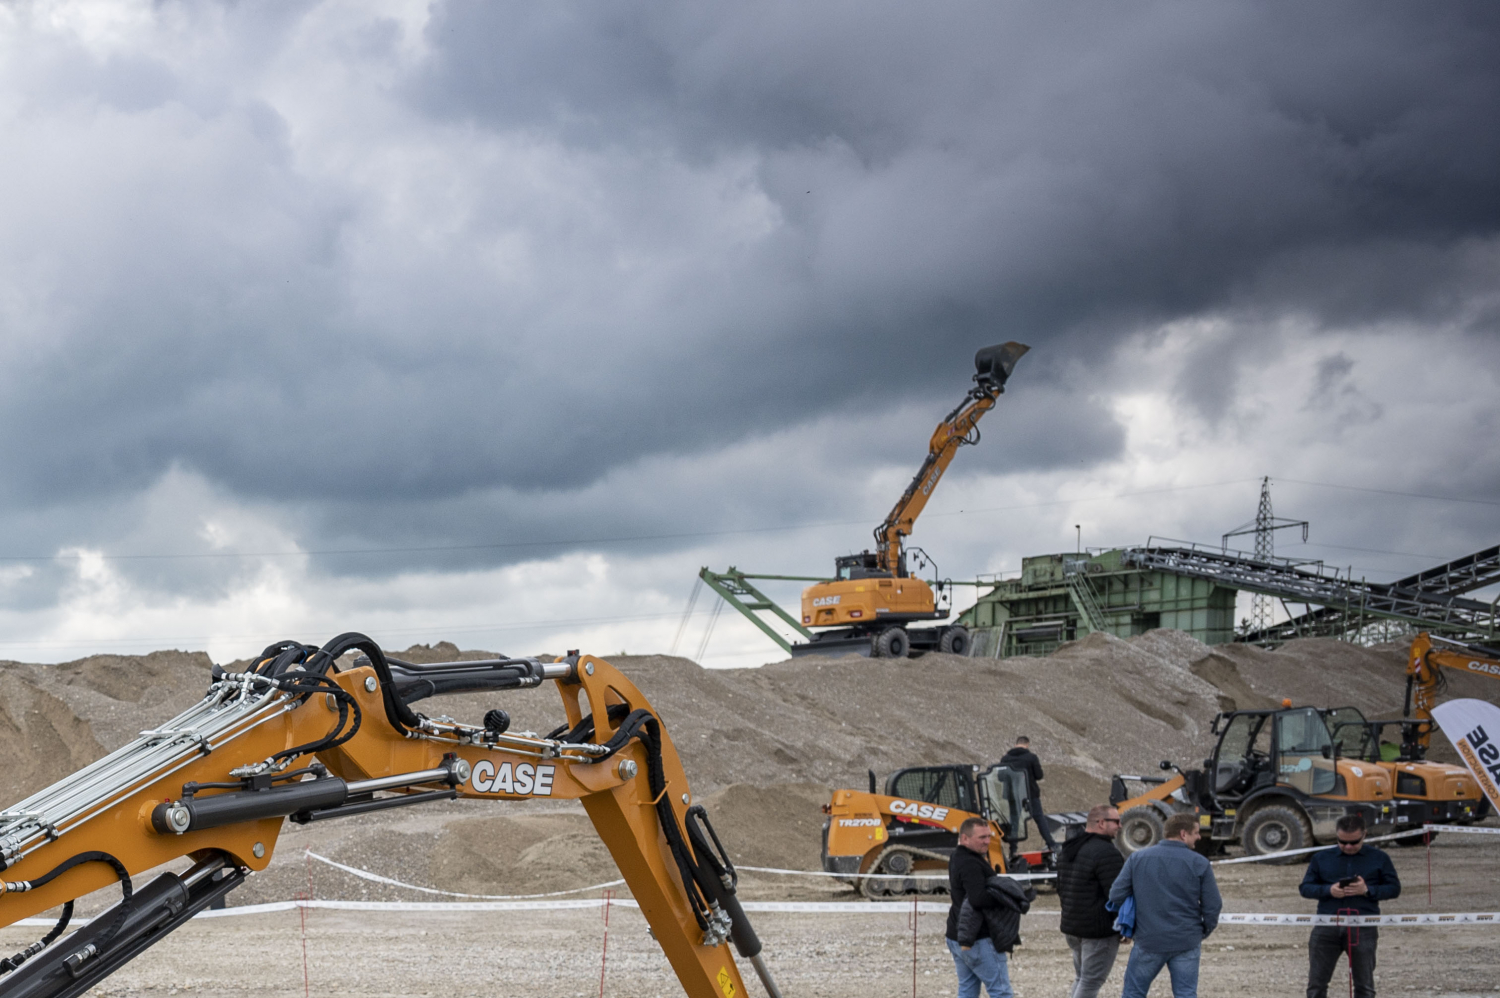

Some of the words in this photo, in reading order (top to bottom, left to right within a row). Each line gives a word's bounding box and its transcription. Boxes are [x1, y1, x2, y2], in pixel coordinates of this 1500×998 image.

[922, 465, 942, 496] CASE
[812, 595, 841, 607] CASE
[1467, 660, 1500, 675] CAS
[471, 759, 556, 796] CASE
[889, 800, 949, 821] CASE
[838, 818, 882, 828] TR270B
